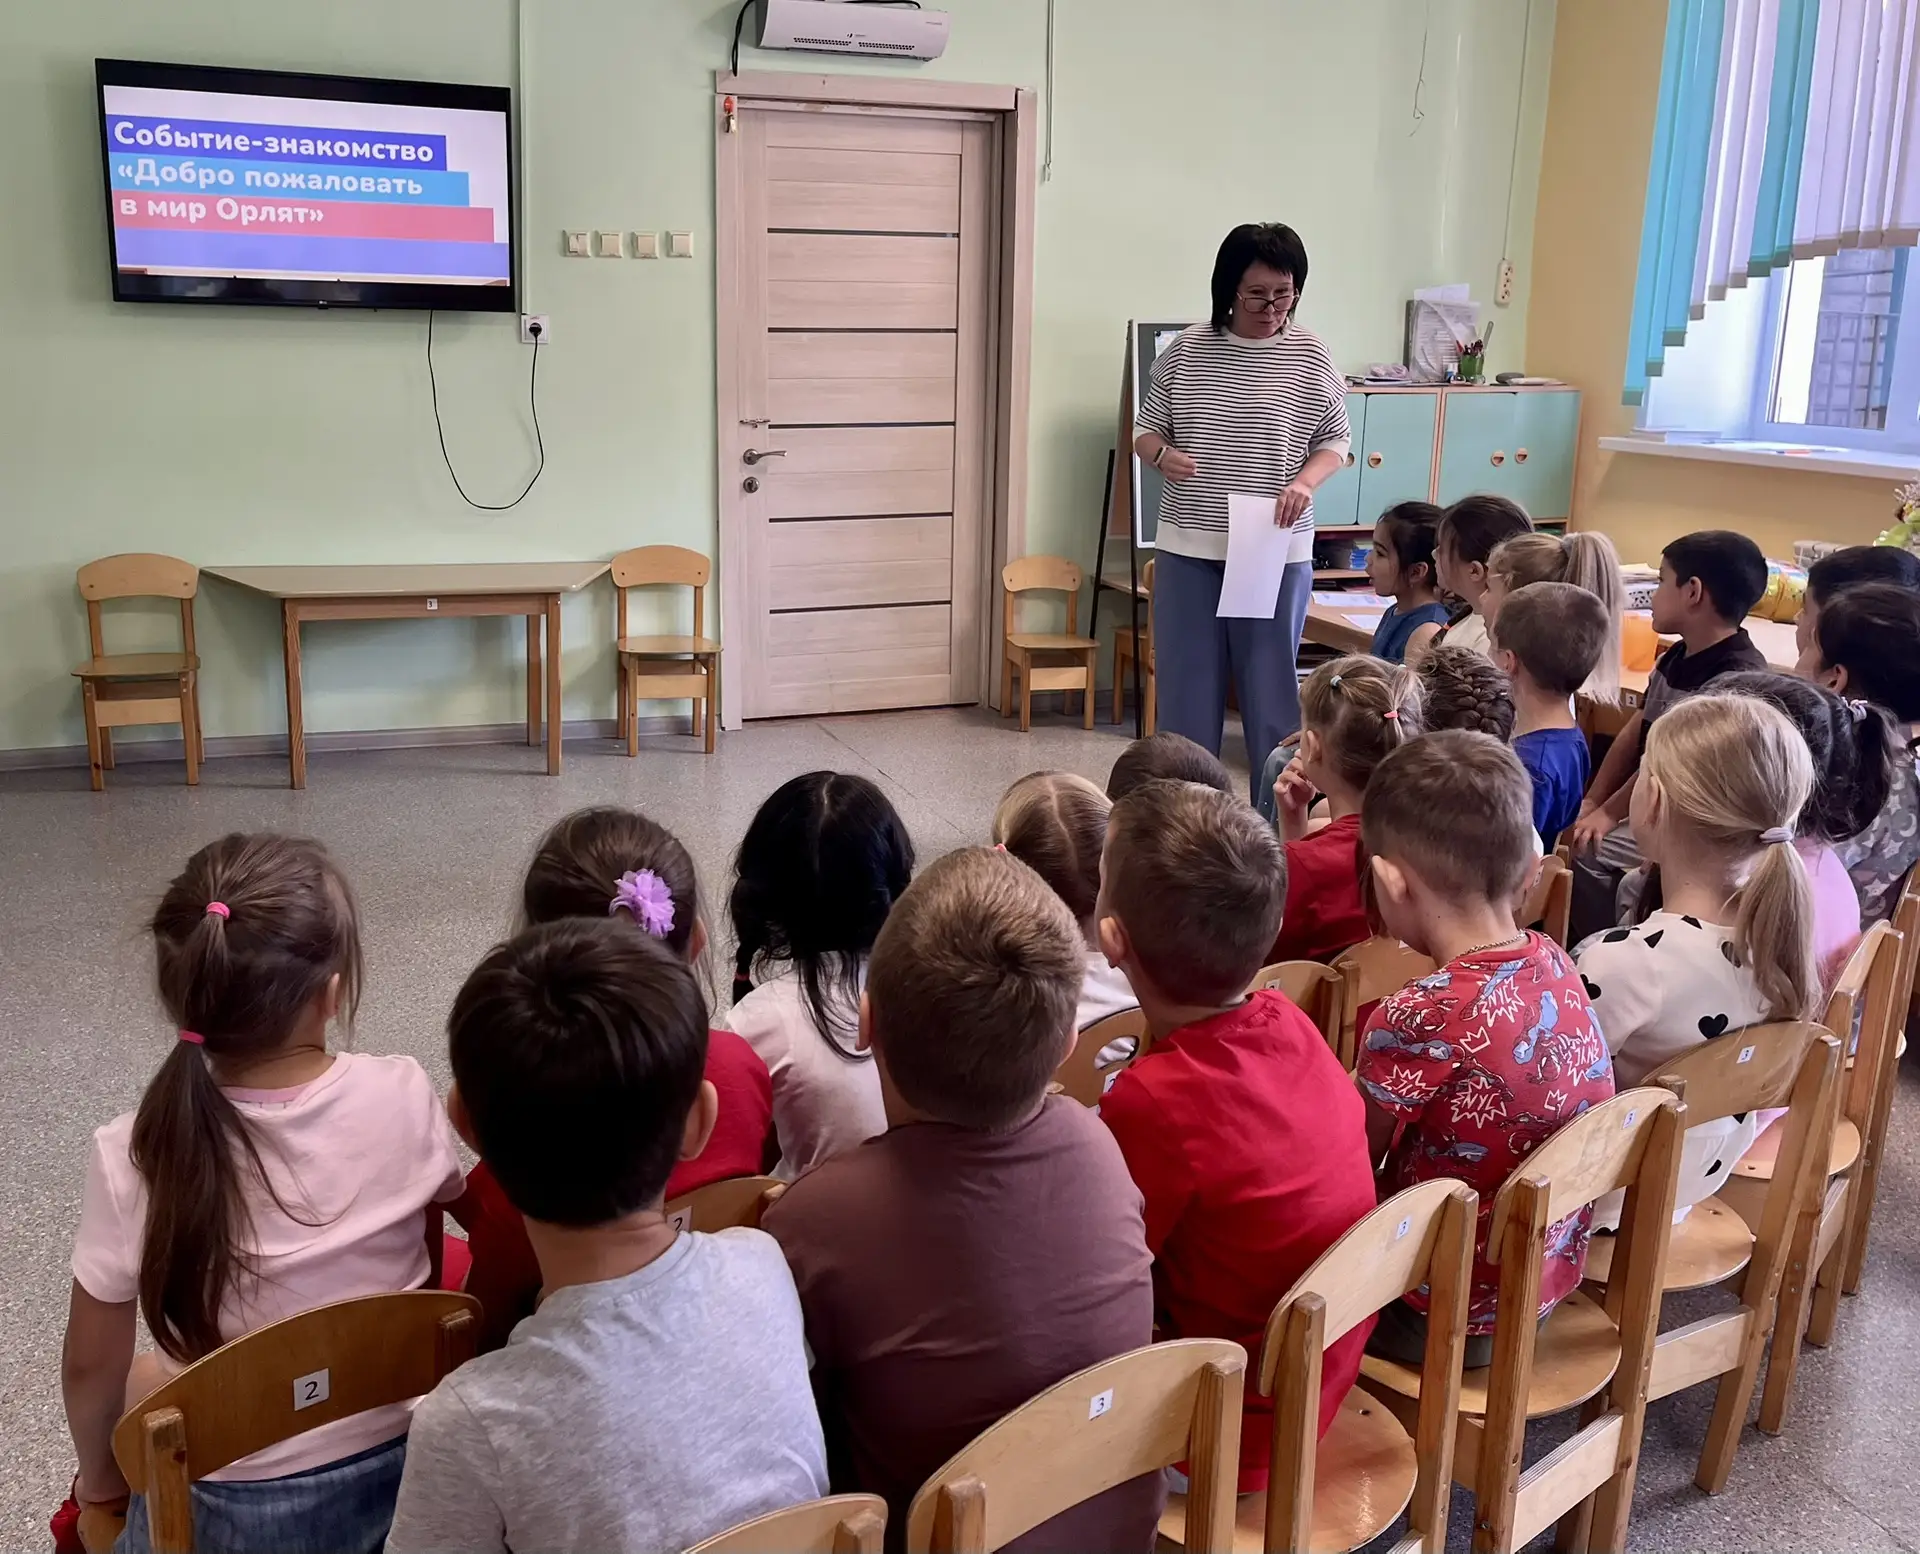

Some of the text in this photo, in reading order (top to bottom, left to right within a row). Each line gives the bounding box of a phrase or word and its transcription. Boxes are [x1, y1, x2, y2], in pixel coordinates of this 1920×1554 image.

[114, 121, 434, 162] Событие-знакомство
[118, 158, 423, 195] «Добро пожаловать
[120, 198, 324, 226] в мир Орлят»
[304, 1380, 320, 1401] 2
[1095, 1396, 1105, 1413] 3
